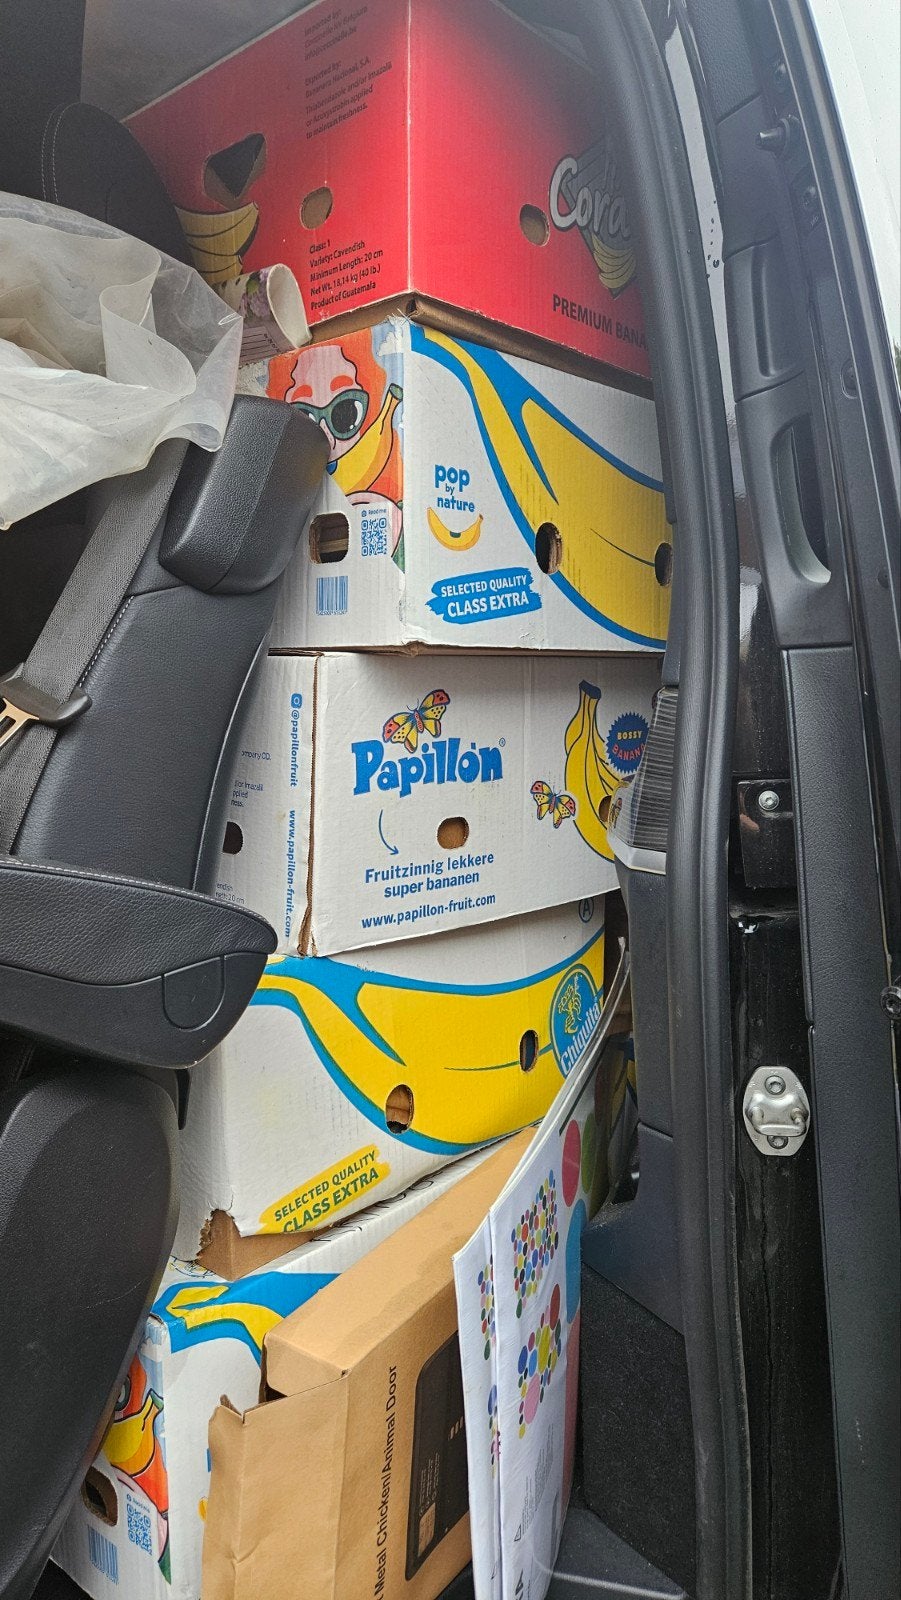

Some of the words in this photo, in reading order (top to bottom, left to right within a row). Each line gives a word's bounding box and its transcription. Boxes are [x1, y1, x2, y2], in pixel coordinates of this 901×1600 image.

[305, 66, 331, 87] Exported
[350, 79, 374, 104] applied
[306, 130, 313, 140] to
[313, 119, 338, 137] maintain
[549, 155, 631, 239] Cora
[309, 242, 327, 254] Class:
[309, 254, 333, 268] Variety:
[333, 240, 366, 260] Cavendish
[310, 265, 339, 283] Minimum
[339, 256, 363, 271] Length:
[364, 252, 373, 262] 20
[373, 249, 384, 258] cm
[310, 285, 321, 297] Net
[350, 272, 359, 283] kg
[310, 295, 335, 311] Product
[335, 291, 342, 302] of
[342, 281, 377, 299] Guatemala
[552, 293, 613, 336] PREMIUM
[434, 464, 471, 493] pop
[445, 483, 455, 496] by
[437, 495, 475, 513] nature
[440, 581, 488, 598] SELECTED
[489, 574, 528, 592] QUALITY
[447, 597, 488, 618] CLASS
[490, 591, 530, 611] EXTRA
[289, 709, 301, 787] @papillonfruit
[617, 730, 642, 740] BOSSY
[284, 809, 296, 938] www.papillon-fruit.com
[365, 858, 444, 883] Fruitzinnig
[447, 852, 494, 871] lekkere
[383, 882, 424, 899] super
[426, 871, 480, 891] bananen
[361, 893, 496, 929] www.papillon-fruit.com
[561, 1002, 601, 1076] Chiquita
[273, 1180, 330, 1222] SELECTED
[331, 1150, 376, 1186] QUALITY
[282, 1197, 331, 1233] CLASS
[332, 1167, 380, 1207] EXTRA
[385, 1365, 398, 1411] Door
[376, 1413, 396, 1547] Chicken/Animal
[374, 1547, 387, 1597] Metal
